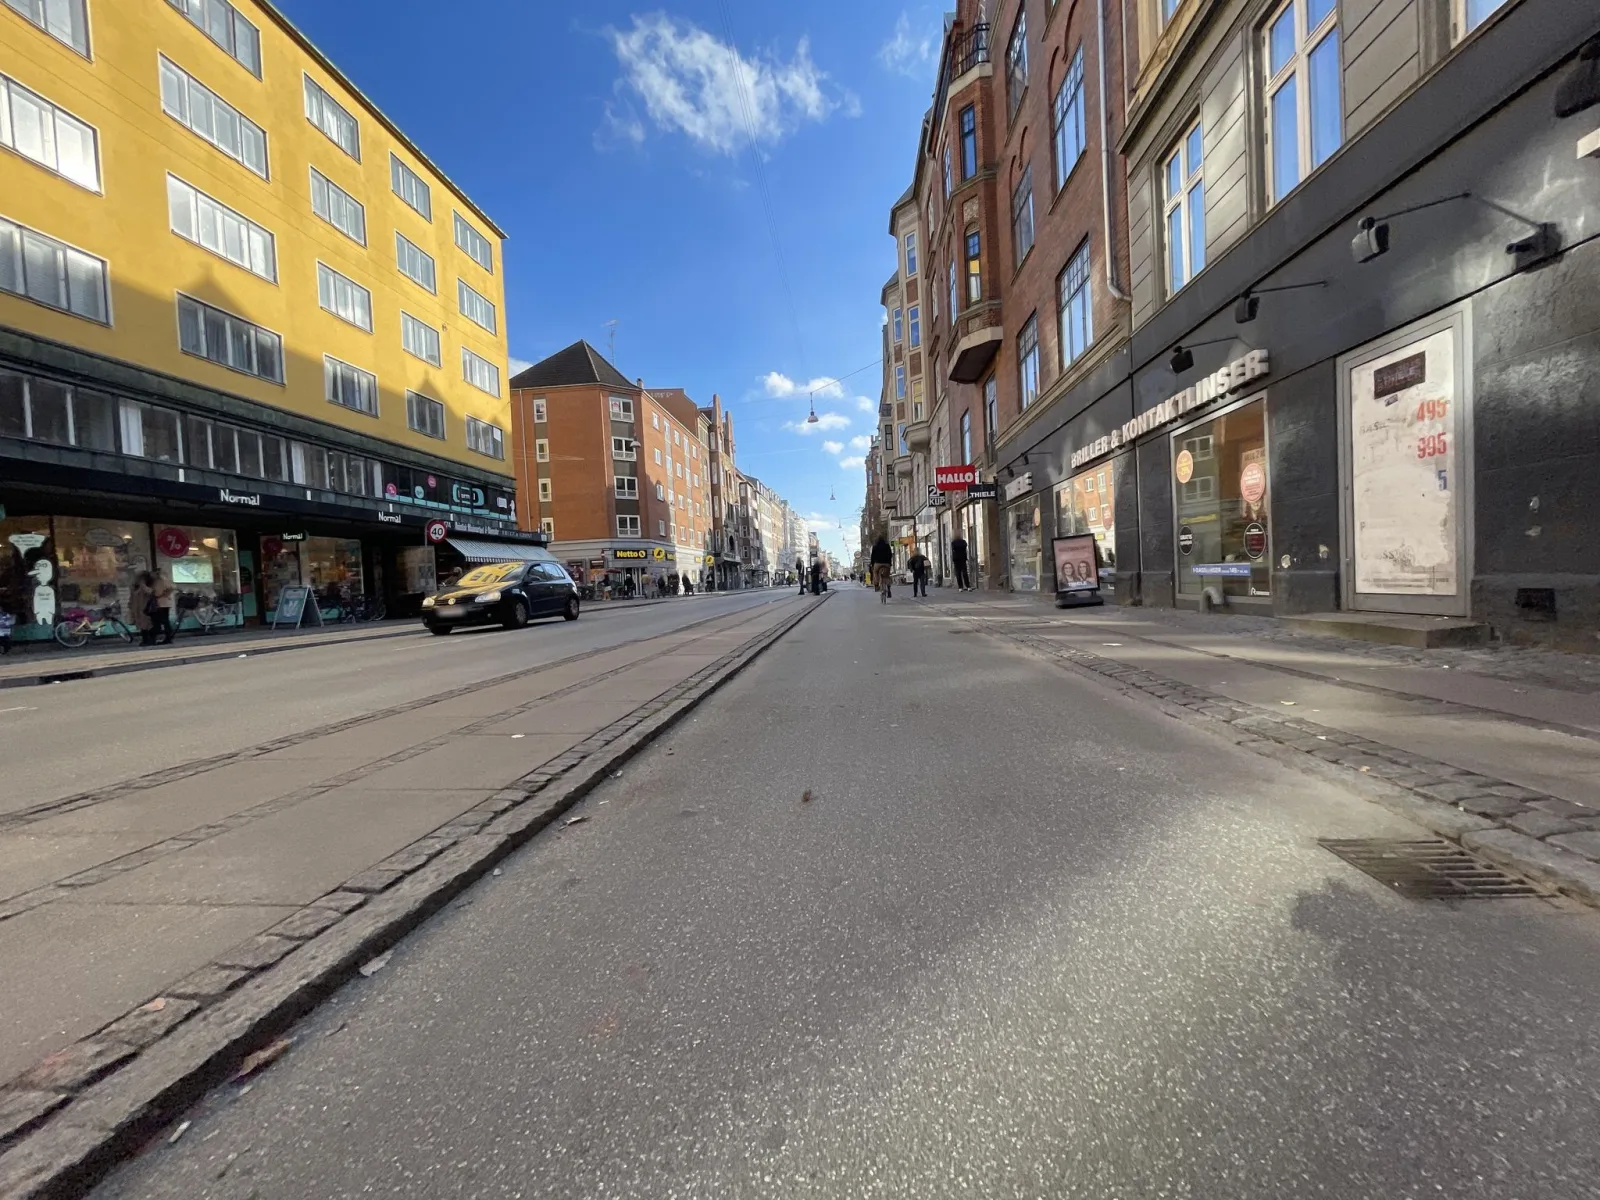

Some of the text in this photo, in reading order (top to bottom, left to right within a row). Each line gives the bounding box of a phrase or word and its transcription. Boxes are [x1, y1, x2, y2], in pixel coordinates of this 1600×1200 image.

[1070, 349, 1268, 468] BRILLER & KONTAKTLINSER
[1417, 400, 1447, 421] 495
[937, 472, 974, 484] HALLO
[220, 489, 260, 505] Normal
[378, 511, 402, 524] Normal
[431, 527, 444, 536] 40
[616, 550, 638, 558] Netto
